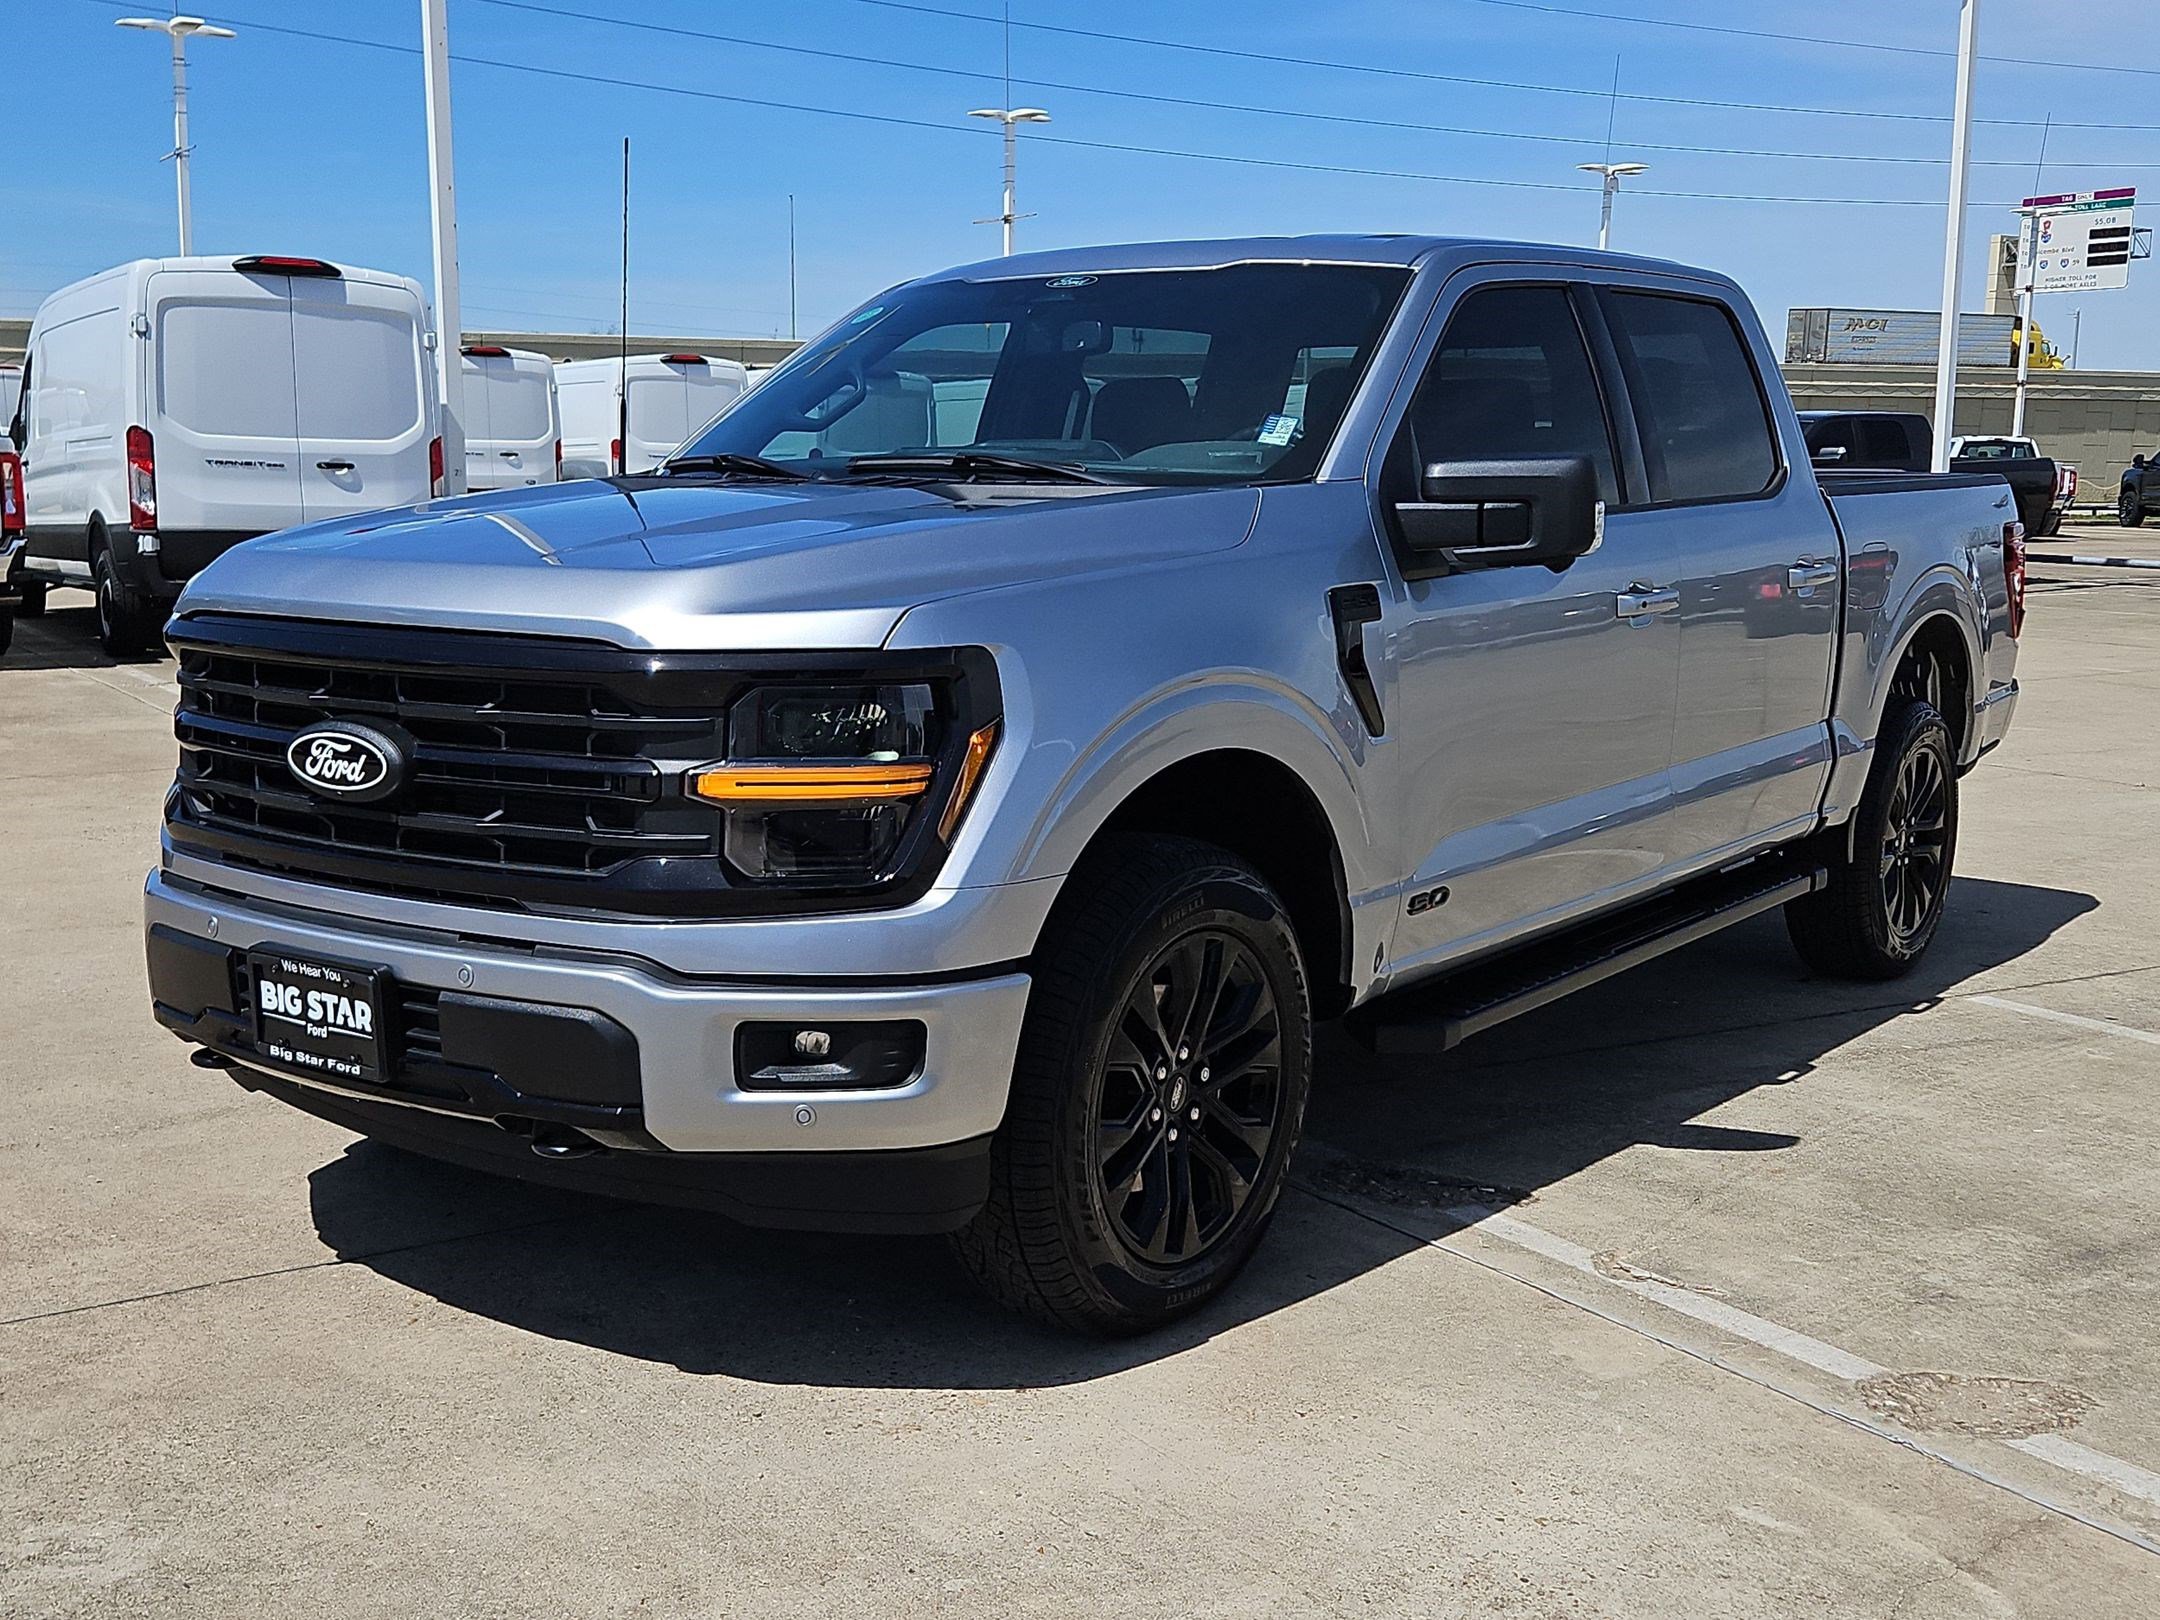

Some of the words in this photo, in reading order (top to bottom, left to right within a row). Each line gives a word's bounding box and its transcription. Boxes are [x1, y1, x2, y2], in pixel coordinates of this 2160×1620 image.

[205, 459, 266, 468] TRANSIT
[305, 738, 367, 783] Ford
[281, 959, 298, 973] We
[299, 963, 321, 978] Hear
[322, 967, 342, 982] You
[260, 980, 302, 1016] BIG
[307, 990, 372, 1033] STAR
[307, 1023, 328, 1038] Ford
[270, 1045, 293, 1061] Big
[296, 1051, 324, 1067] Star
[328, 1058, 361, 1075] Ford
